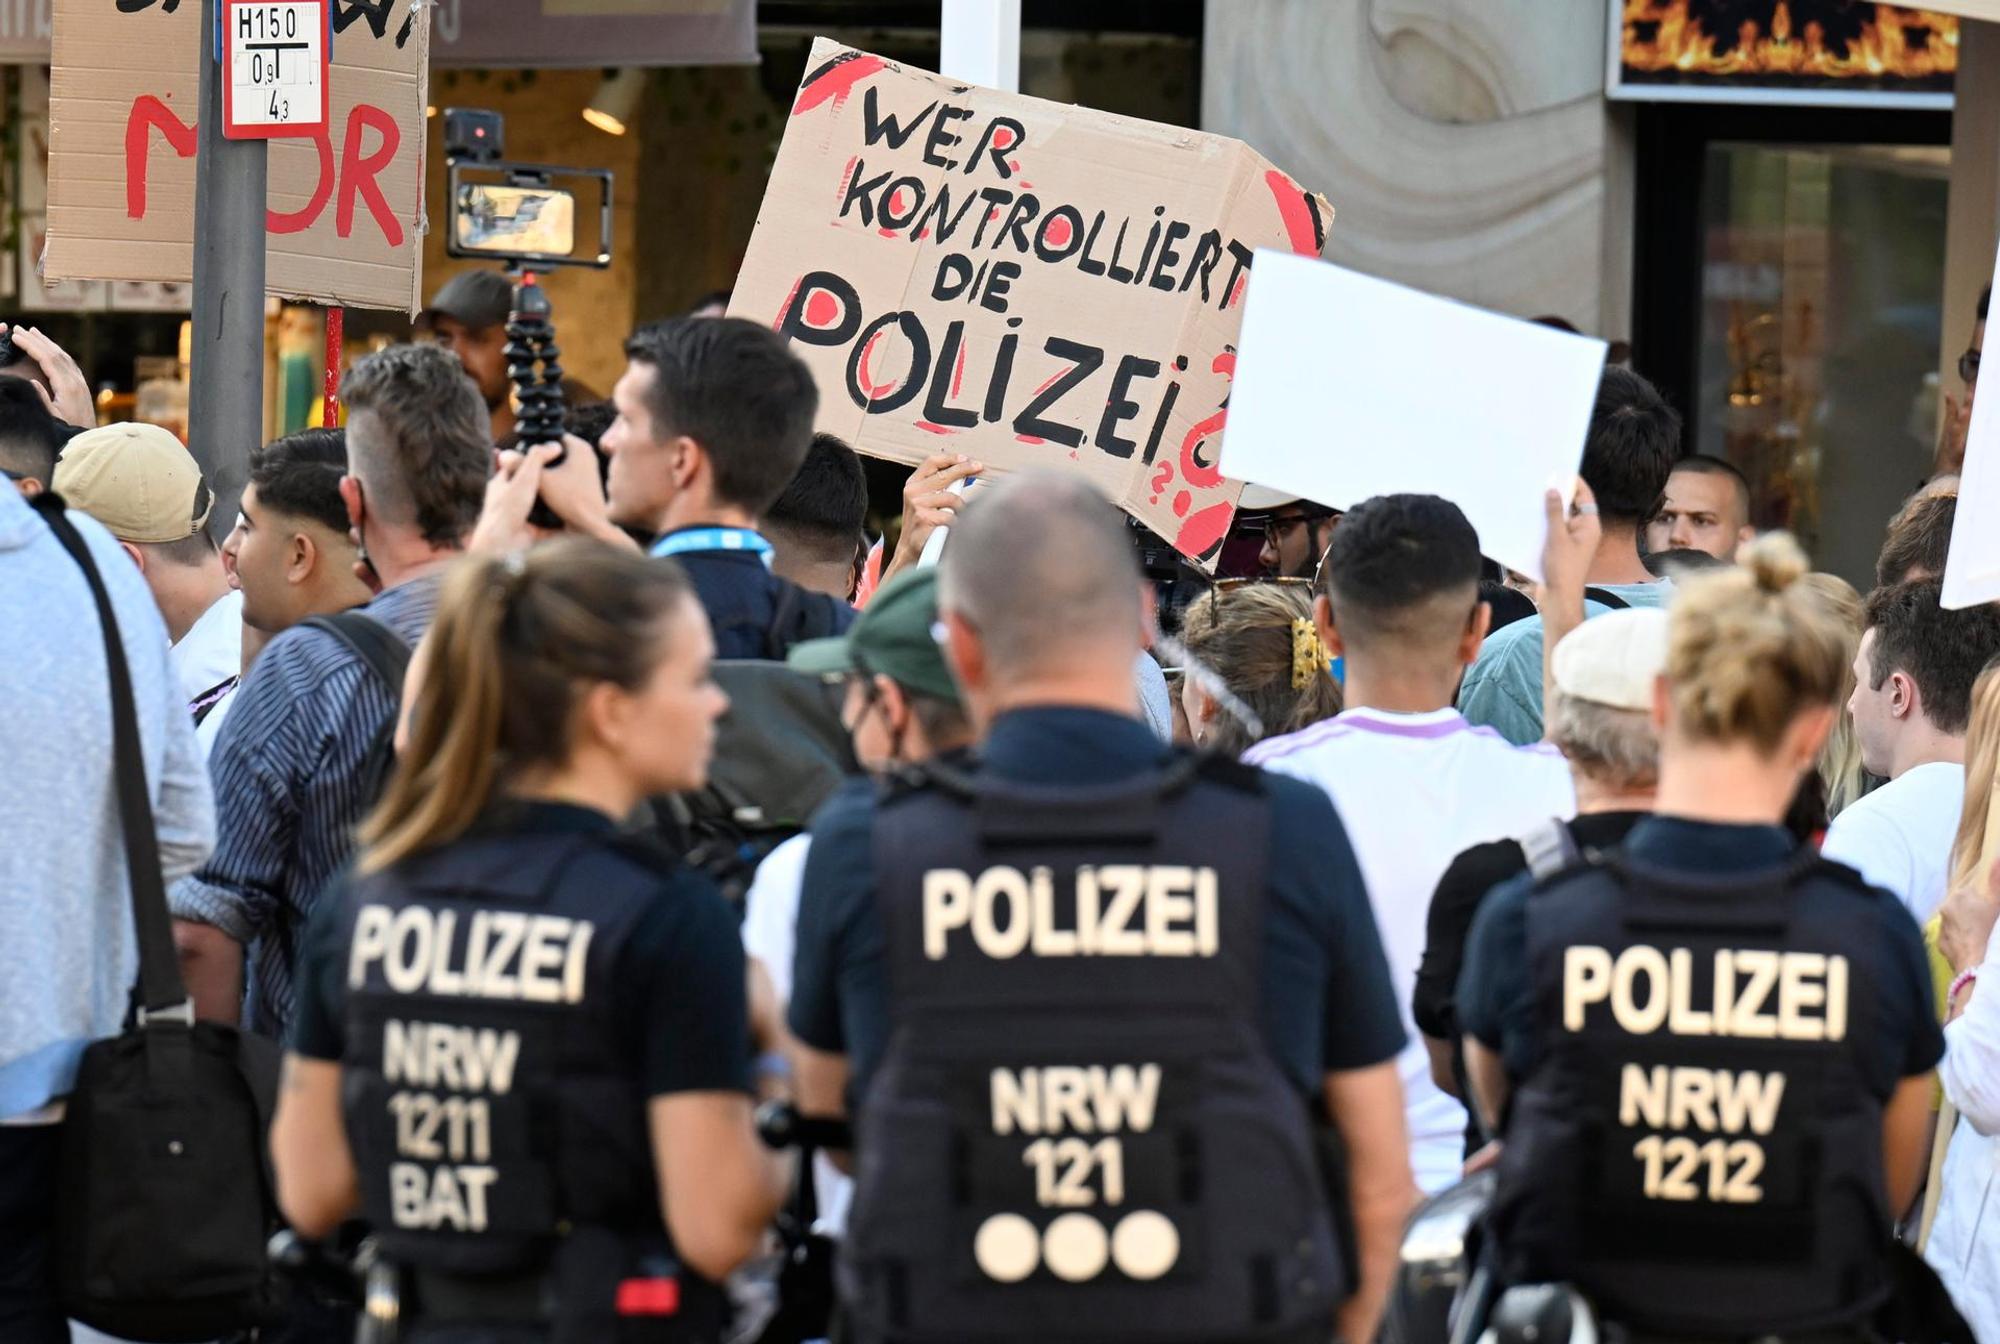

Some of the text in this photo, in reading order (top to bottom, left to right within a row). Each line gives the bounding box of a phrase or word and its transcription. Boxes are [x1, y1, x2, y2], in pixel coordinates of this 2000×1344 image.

[239, 8, 296, 38] H150
[863, 86, 1026, 179] WER
[931, 253, 1022, 313] DIE
[923, 865, 1219, 960] POLIZEI
[348, 904, 594, 1002] POLIZEI
[1563, 945, 1849, 1042] POLIZEI
[383, 1020, 519, 1092] NRW
[388, 1096, 490, 1160] 1211
[990, 1064, 1162, 1134] NRW
[1619, 1064, 1786, 1134] NRW
[390, 1163, 498, 1231] BAT
[1023, 1137, 1124, 1207] 121
[1633, 1136, 1765, 1202] 1212
